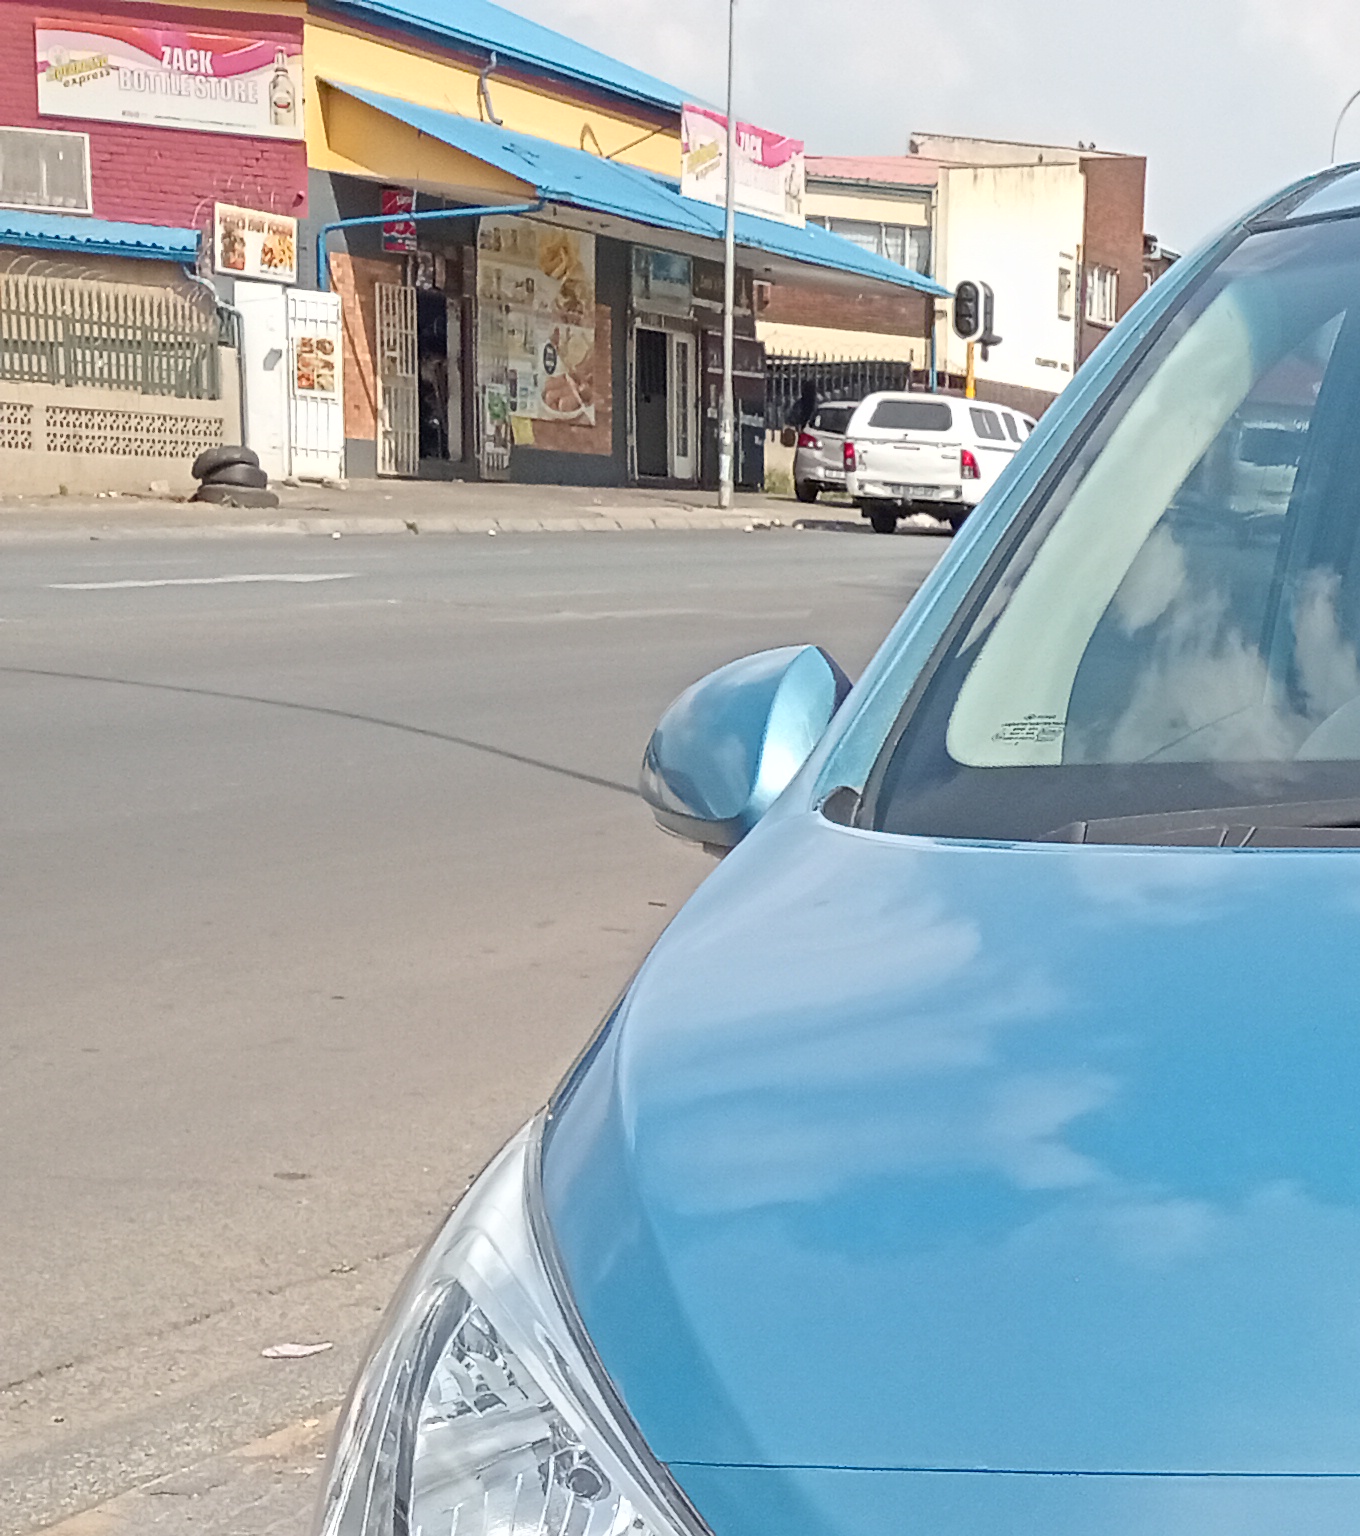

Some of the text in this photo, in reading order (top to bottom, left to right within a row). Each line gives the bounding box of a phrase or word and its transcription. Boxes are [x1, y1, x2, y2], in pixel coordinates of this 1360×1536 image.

[161, 46, 213, 75] ZACK
[117, 68, 190, 97] BOTTLE
[194, 75, 258, 104] STORE
